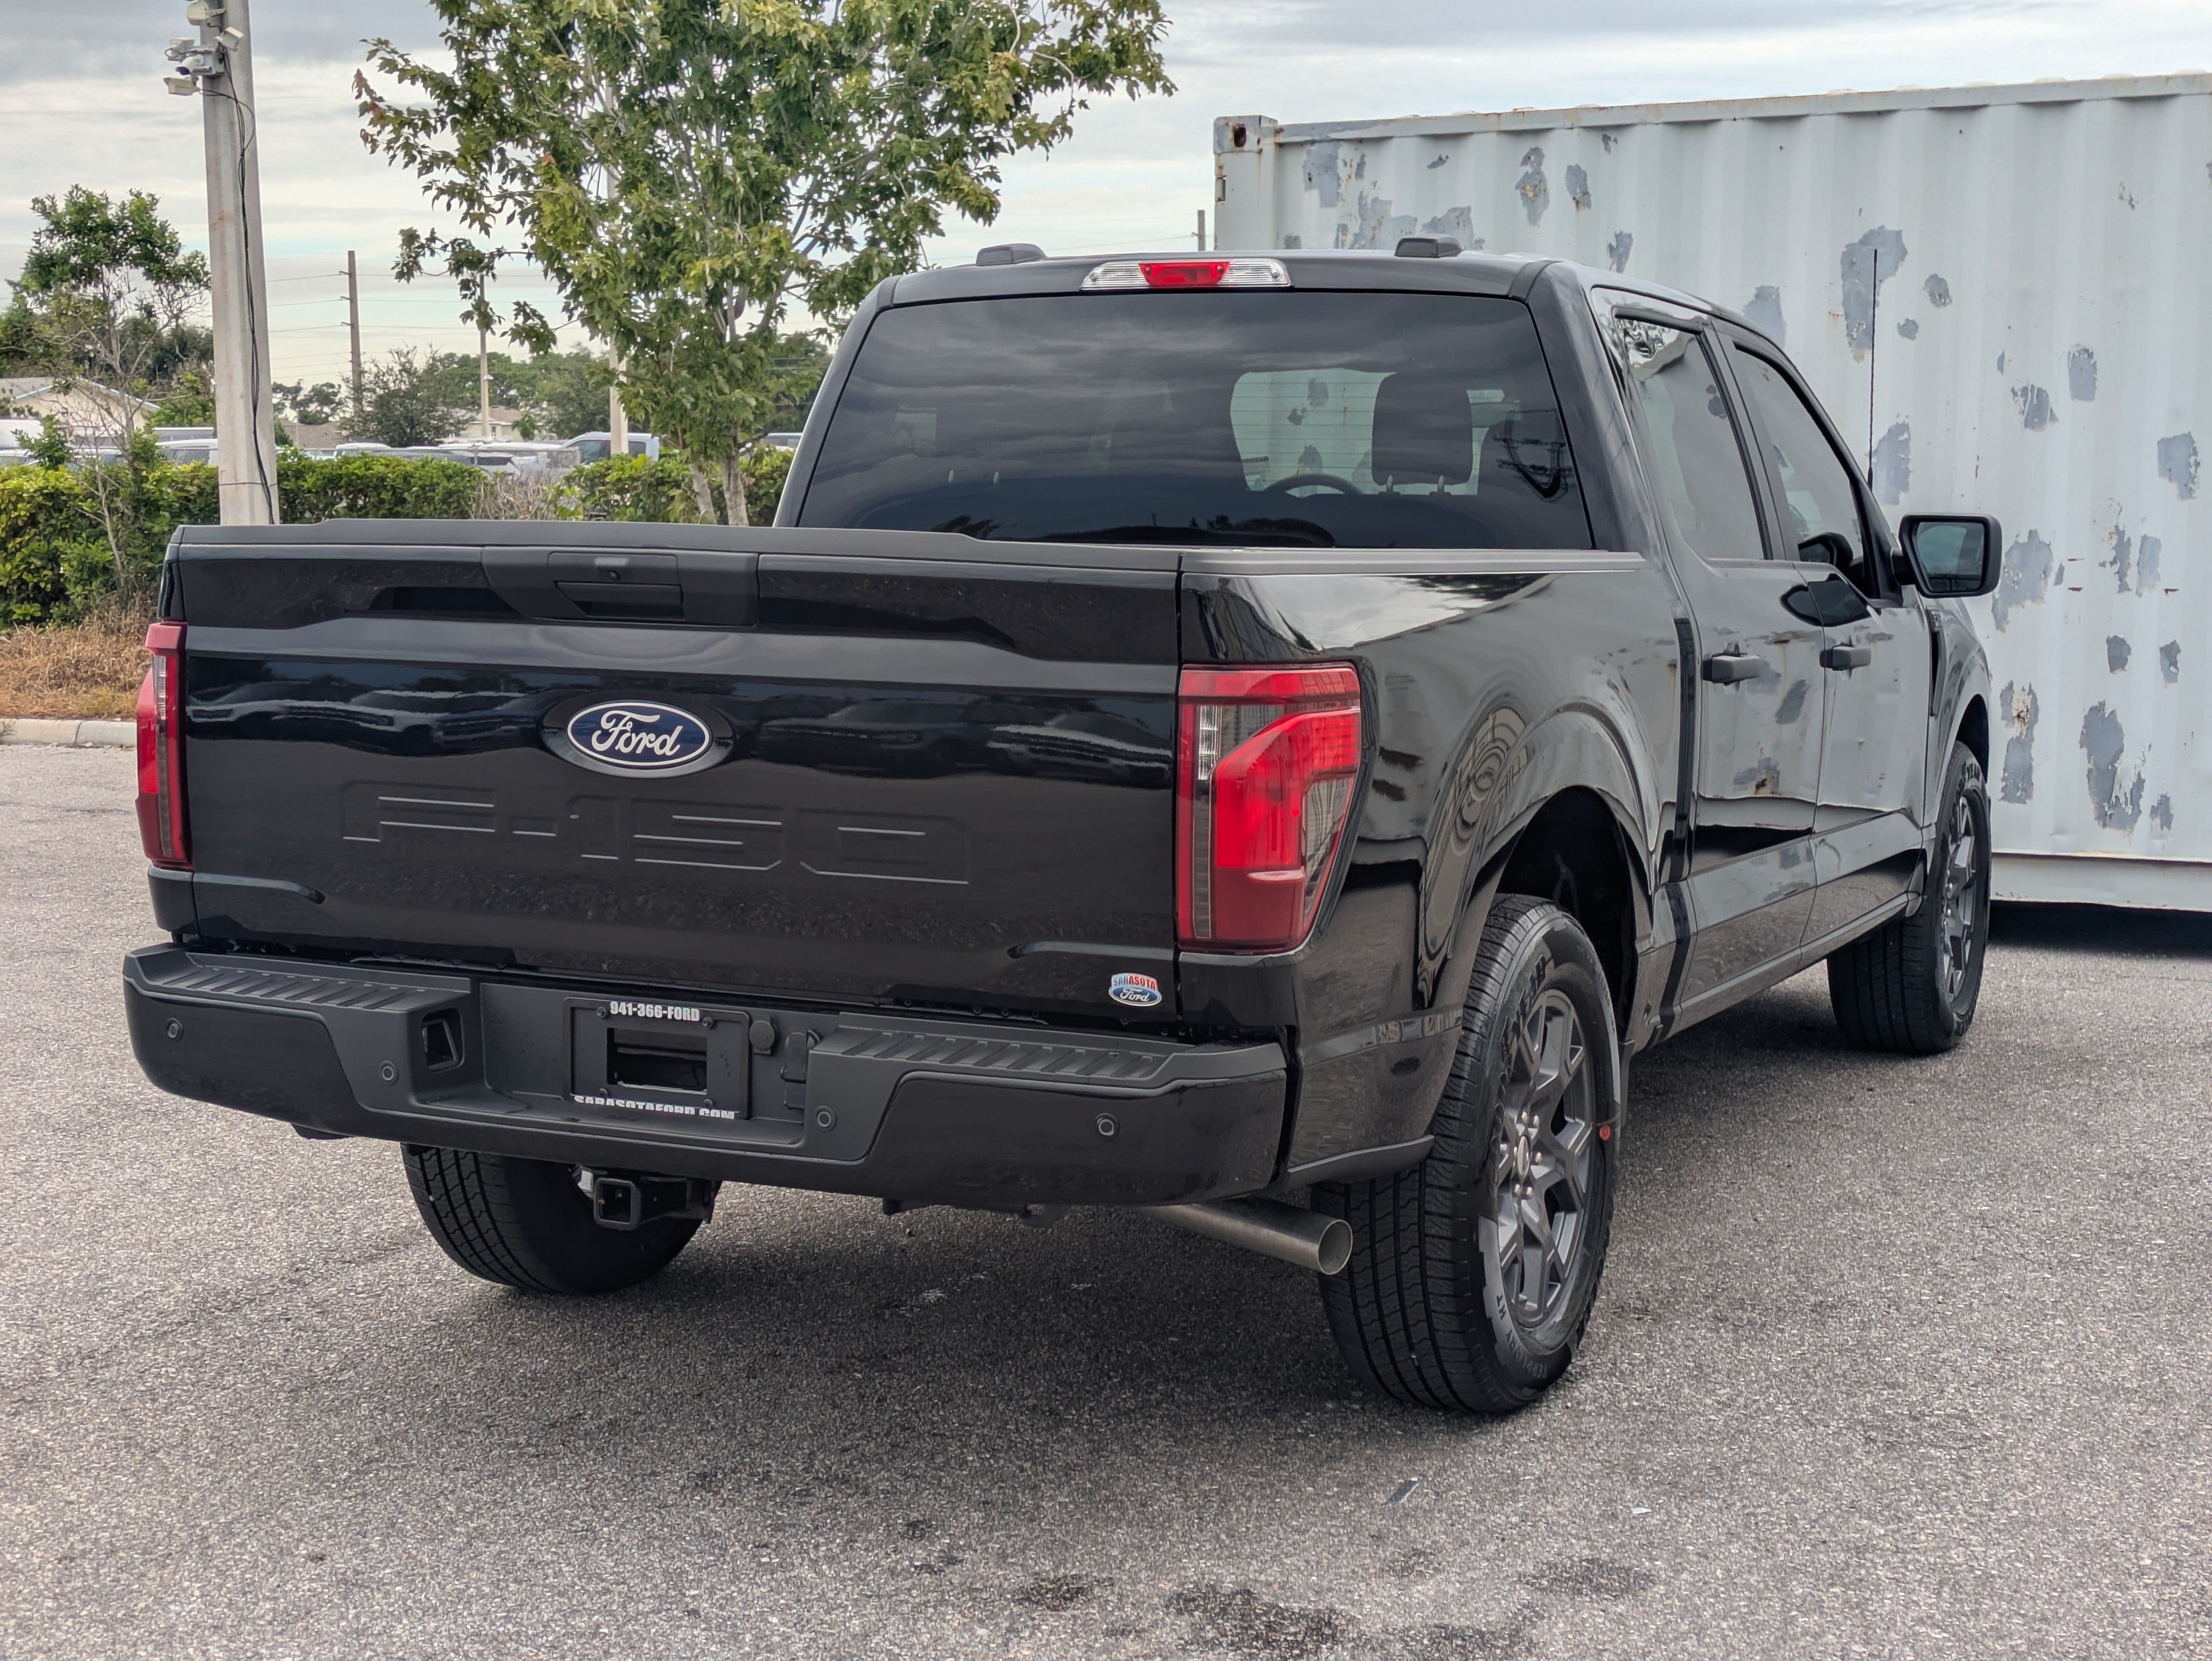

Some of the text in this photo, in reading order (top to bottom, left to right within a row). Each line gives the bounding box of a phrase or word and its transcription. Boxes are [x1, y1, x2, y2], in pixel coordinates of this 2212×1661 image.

[591, 710, 683, 756] Ford
[1113, 975, 1156, 991] SARASOTA
[1120, 987, 1150, 1002] Ford
[609, 1001, 700, 1021] 941-366-FORD
